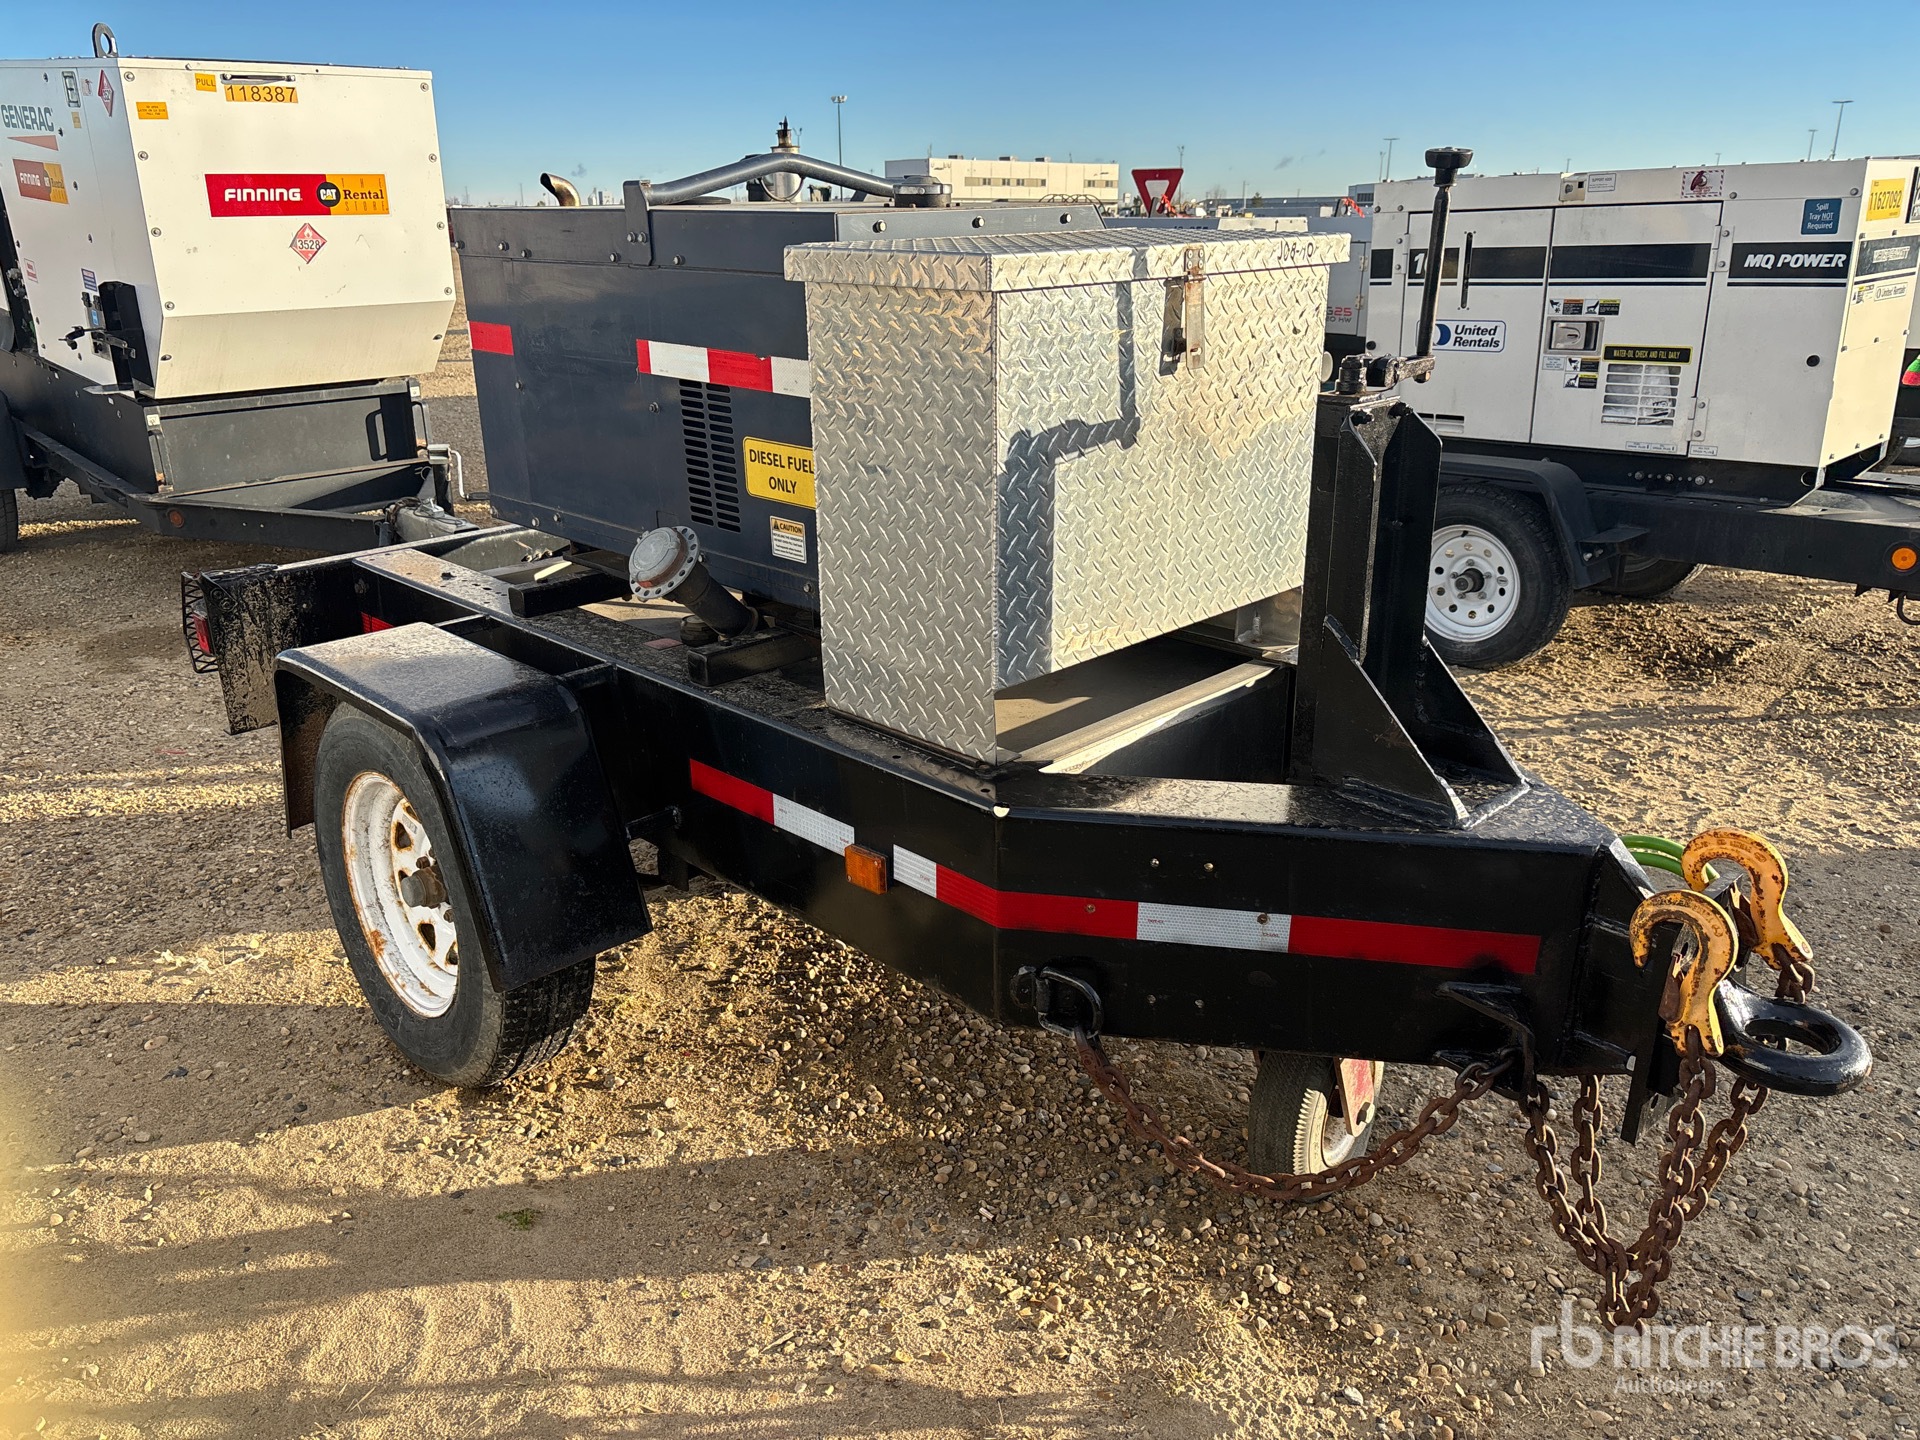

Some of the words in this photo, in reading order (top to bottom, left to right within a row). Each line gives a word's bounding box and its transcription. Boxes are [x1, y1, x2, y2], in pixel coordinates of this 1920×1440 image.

[196, 77, 216, 87] PULL
[227, 85, 296, 102] 118387
[0, 104, 55, 132] GENERAC
[224, 188, 302, 202] FINNING
[320, 189, 337, 200] CAT
[343, 189, 384, 200] Rental
[345, 201, 388, 212] STORE
[1816, 202, 1830, 212] Spill
[1809, 212, 1821, 222] Tray
[1821, 212, 1834, 221] NOT
[1806, 221, 1834, 231] Required
[298, 239, 321, 250] 3528
[1413, 252, 1429, 275] 1
[1743, 254, 1775, 270] MQ
[1776, 253, 1847, 268] POWER
[1454, 324, 1499, 337] United
[1453, 336, 1501, 348] Rentals
[1658, 351, 1667, 359] FILL
[1668, 351, 1681, 359] DAILY
[749, 449, 785, 469] DIESEL
[787, 456, 815, 474] FUEL
[768, 476, 798, 495] ONLY
[779, 522, 803, 534] CAUTION
